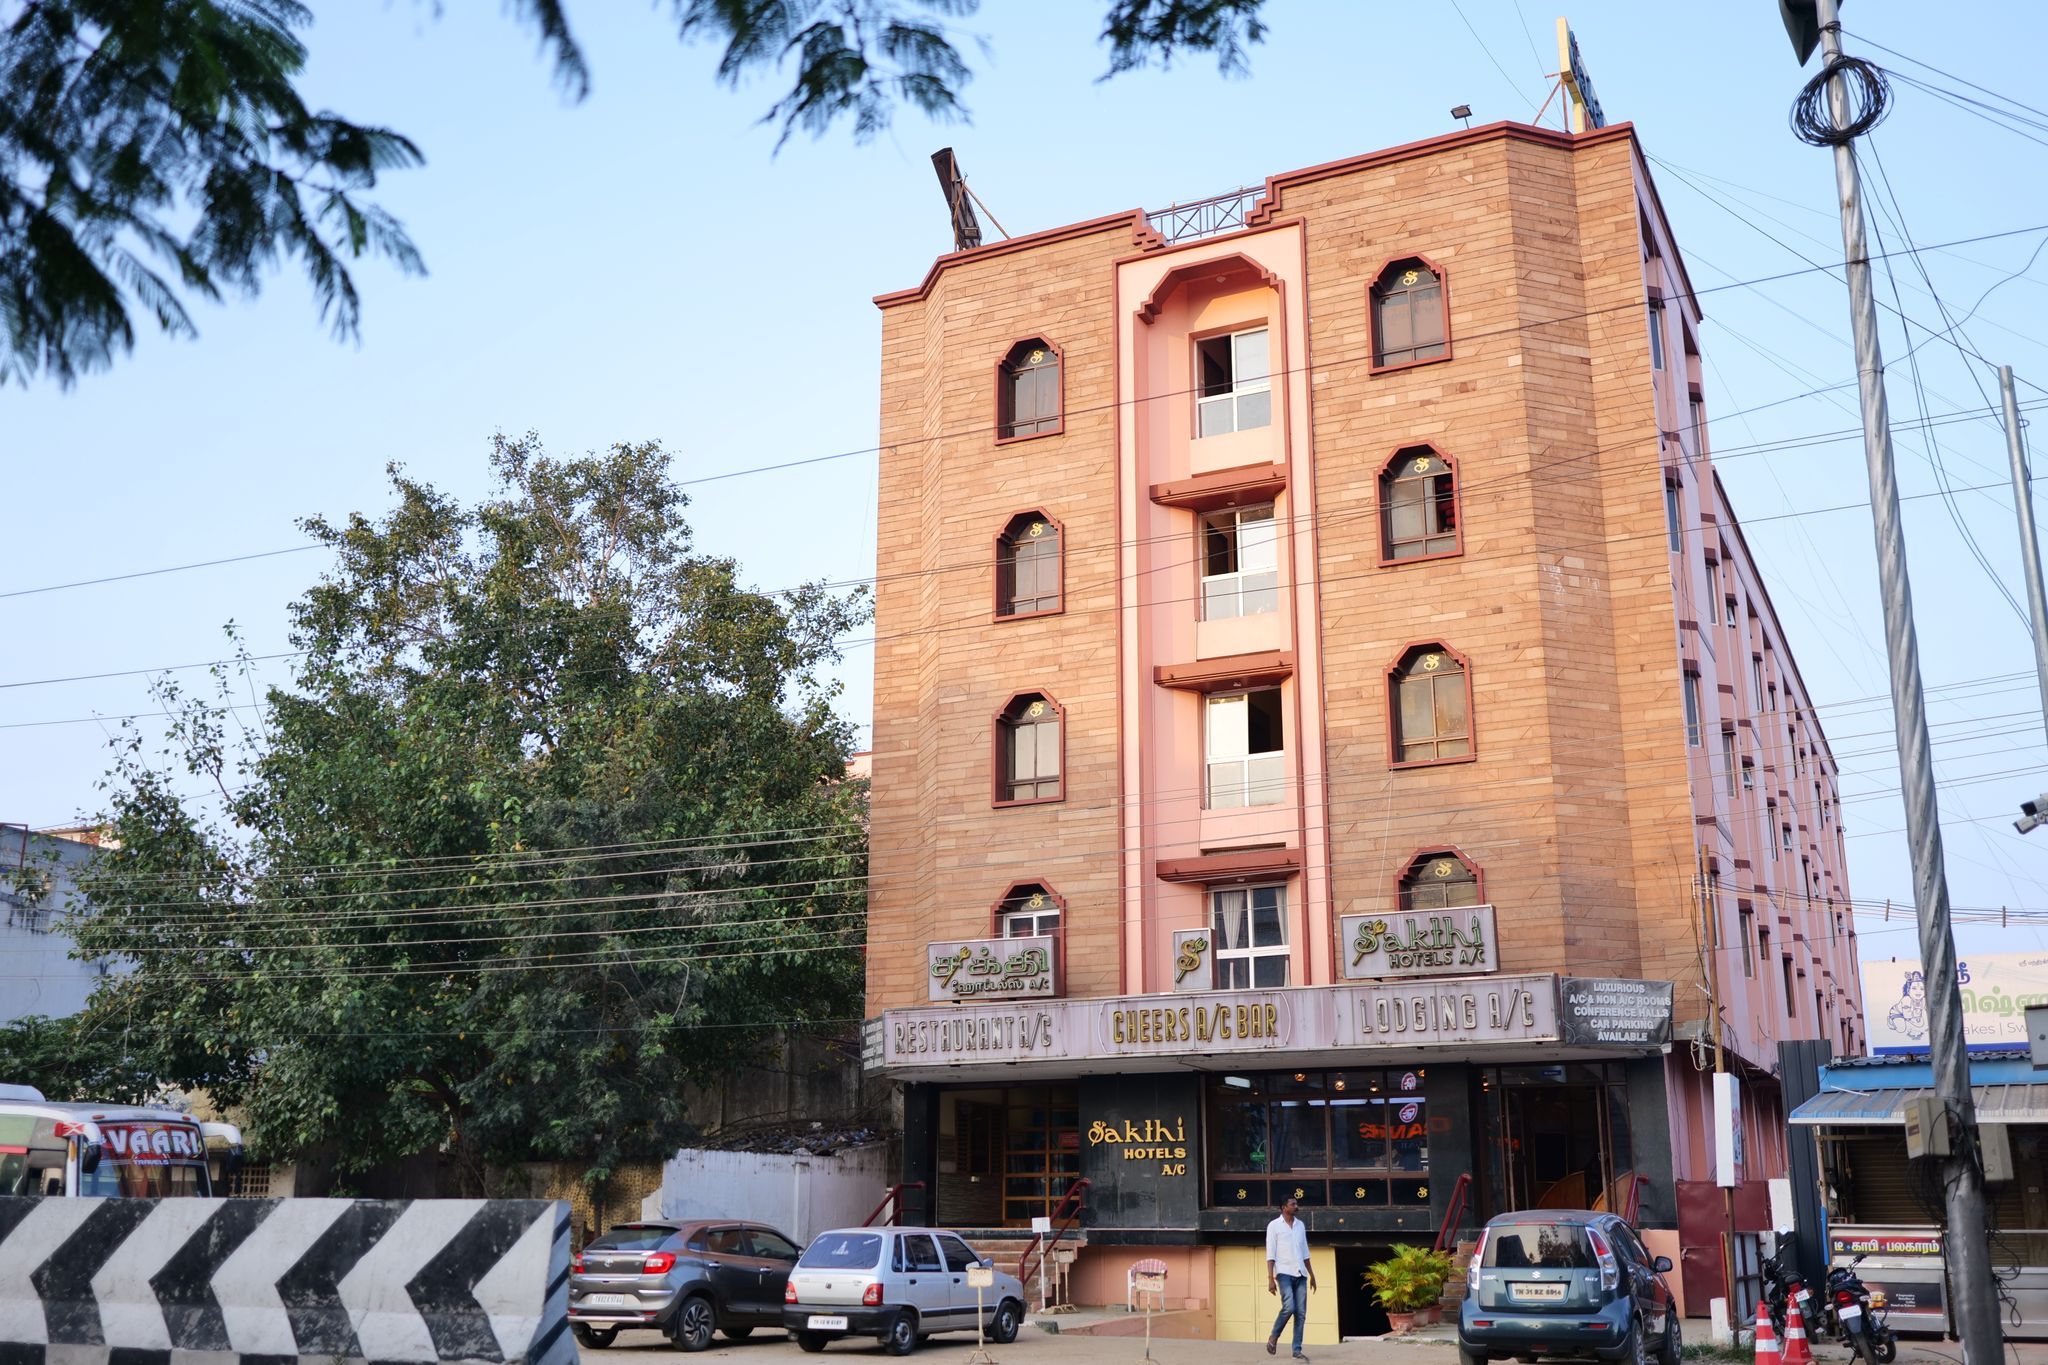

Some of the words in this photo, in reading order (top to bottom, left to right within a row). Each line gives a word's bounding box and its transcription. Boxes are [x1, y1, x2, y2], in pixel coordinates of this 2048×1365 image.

[1353, 915, 1484, 955] Sakthi
[931, 946, 1050, 980] சக்தி
[1389, 951, 1453, 969] HOTELS
[1459, 947, 1485, 966] A/C
[1029, 977, 1050, 992] A/C
[1593, 982, 1645, 993] LUXURIOUS
[1569, 994, 1586, 1004] A/C
[1586, 994, 1595, 1004] &
[1596, 995, 1616, 1004] NON
[1619, 996, 1635, 1005] A/C
[1636, 996, 1672, 1006] ROOMS
[1360, 994, 1478, 1033] LODGING
[1488, 989, 1534, 1030] A/C
[1574, 1006, 1637, 1017] CONFERENCE
[1640, 1007, 1670, 1018] HALLS
[1113, 1007, 1190, 1043] CHEERS
[1195, 1003, 1231, 1043] A/C
[1236, 1003, 1278, 1038] BAR
[1590, 1019, 1610, 1028] CAR
[1612, 1019, 1654, 1030] PARKING
[1963, 1022, 1996, 1035] akes
[895, 1016, 1015, 1053] RESTAURANT
[1018, 1012, 1052, 1050] A/C
[1598, 1031, 1648, 1041] AVAILABLE
[1088, 1116, 1185, 1145] Sakthi
[1124, 1147, 1187, 1159] HOTELS
[1161, 1163, 1185, 1176] A/C
[1851, 1239, 1878, 1252] காபி
[1886, 1239, 1940, 1254] பலகாரம்
